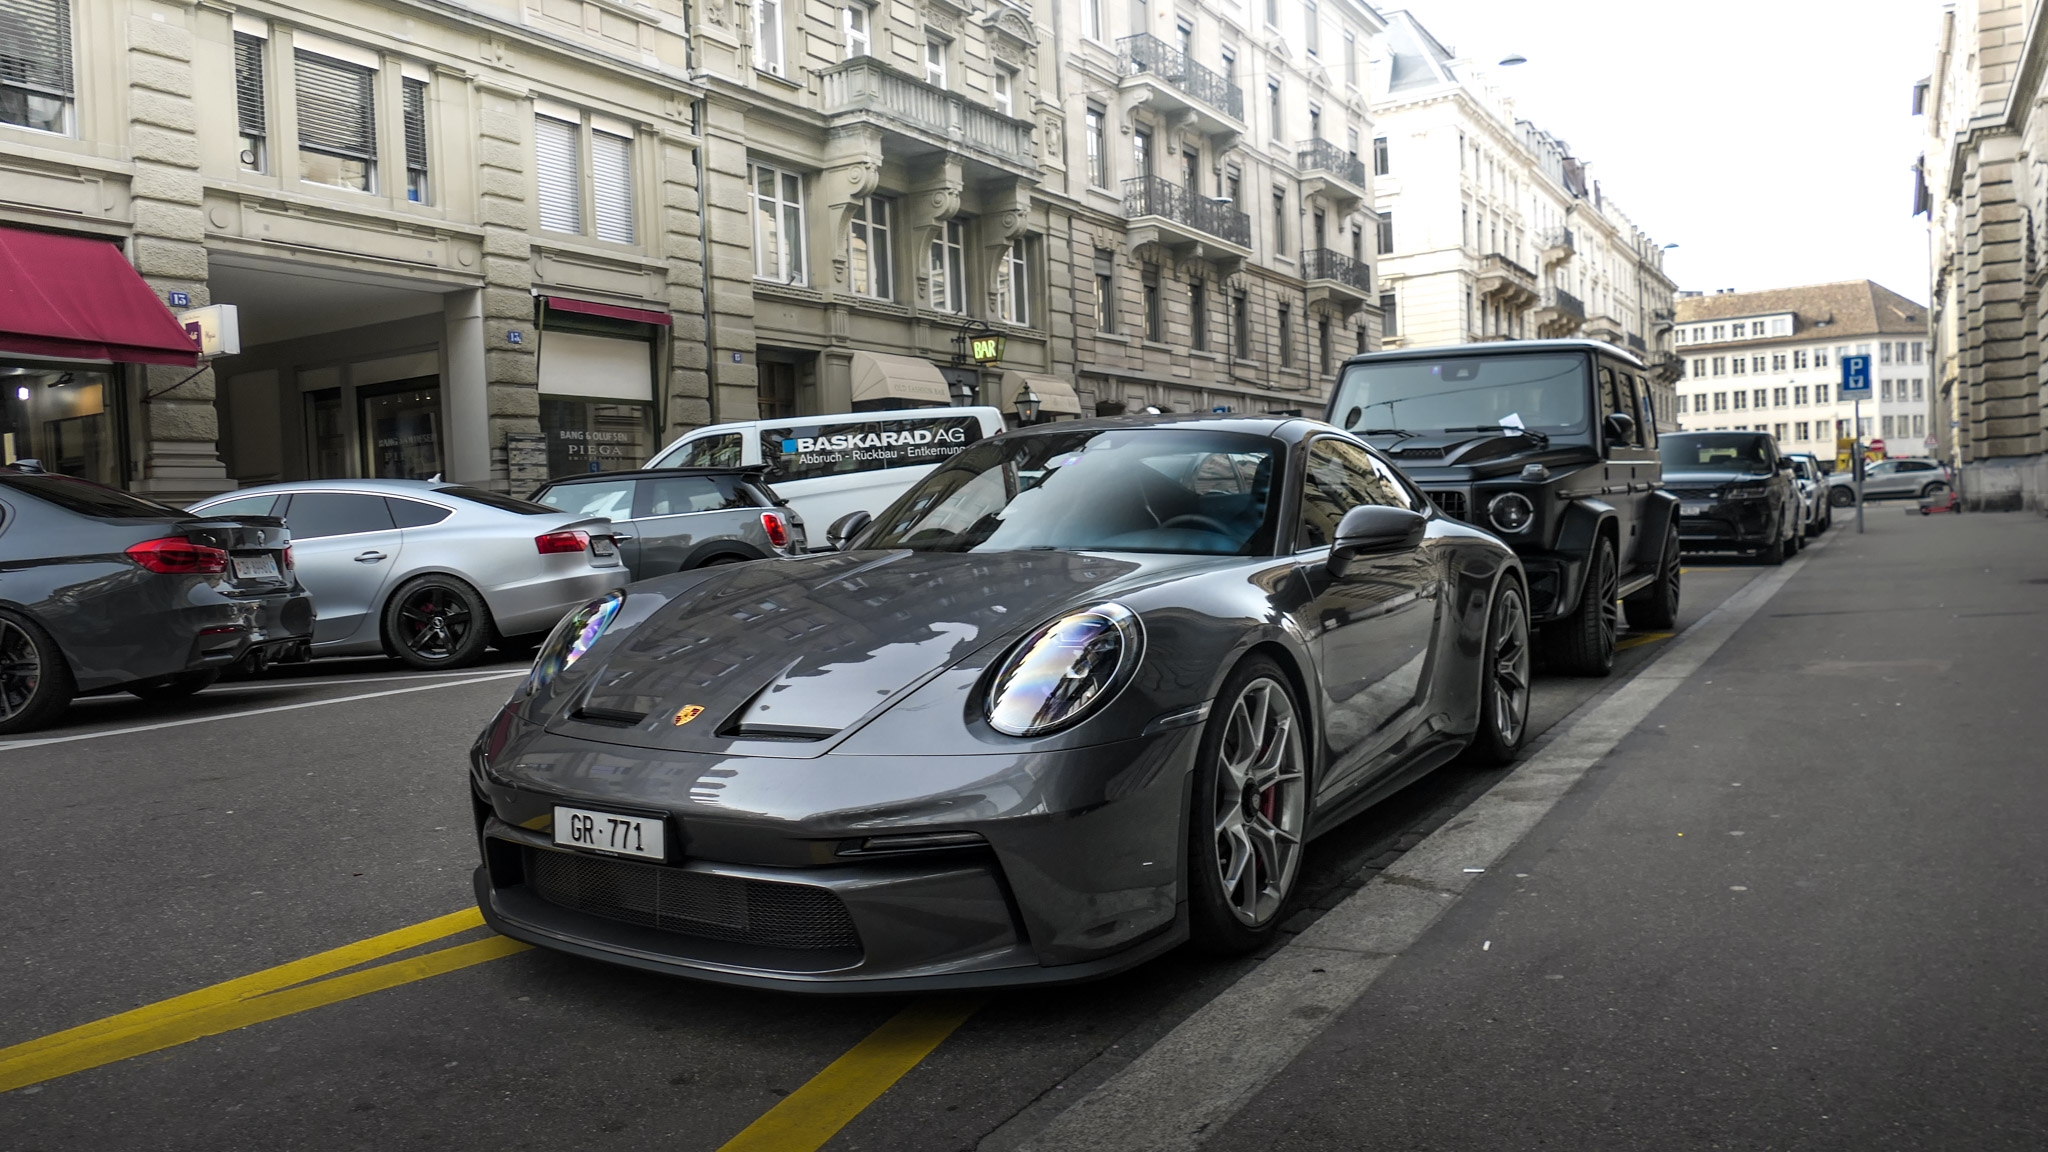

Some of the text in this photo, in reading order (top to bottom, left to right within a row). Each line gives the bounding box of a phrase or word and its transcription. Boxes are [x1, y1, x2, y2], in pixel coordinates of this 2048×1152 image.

[173, 293, 187, 305] 13
[973, 340, 997, 359] BAR
[1850, 358, 1863, 376] P
[560, 431, 584, 440] BANG
[592, 432, 628, 441] OLUFSEN
[798, 428, 966, 453] BASKARAD AG
[568, 445, 622, 455] PIEGA
[799, 453, 843, 465] Abbruch
[853, 449, 898, 462] Rückbau
